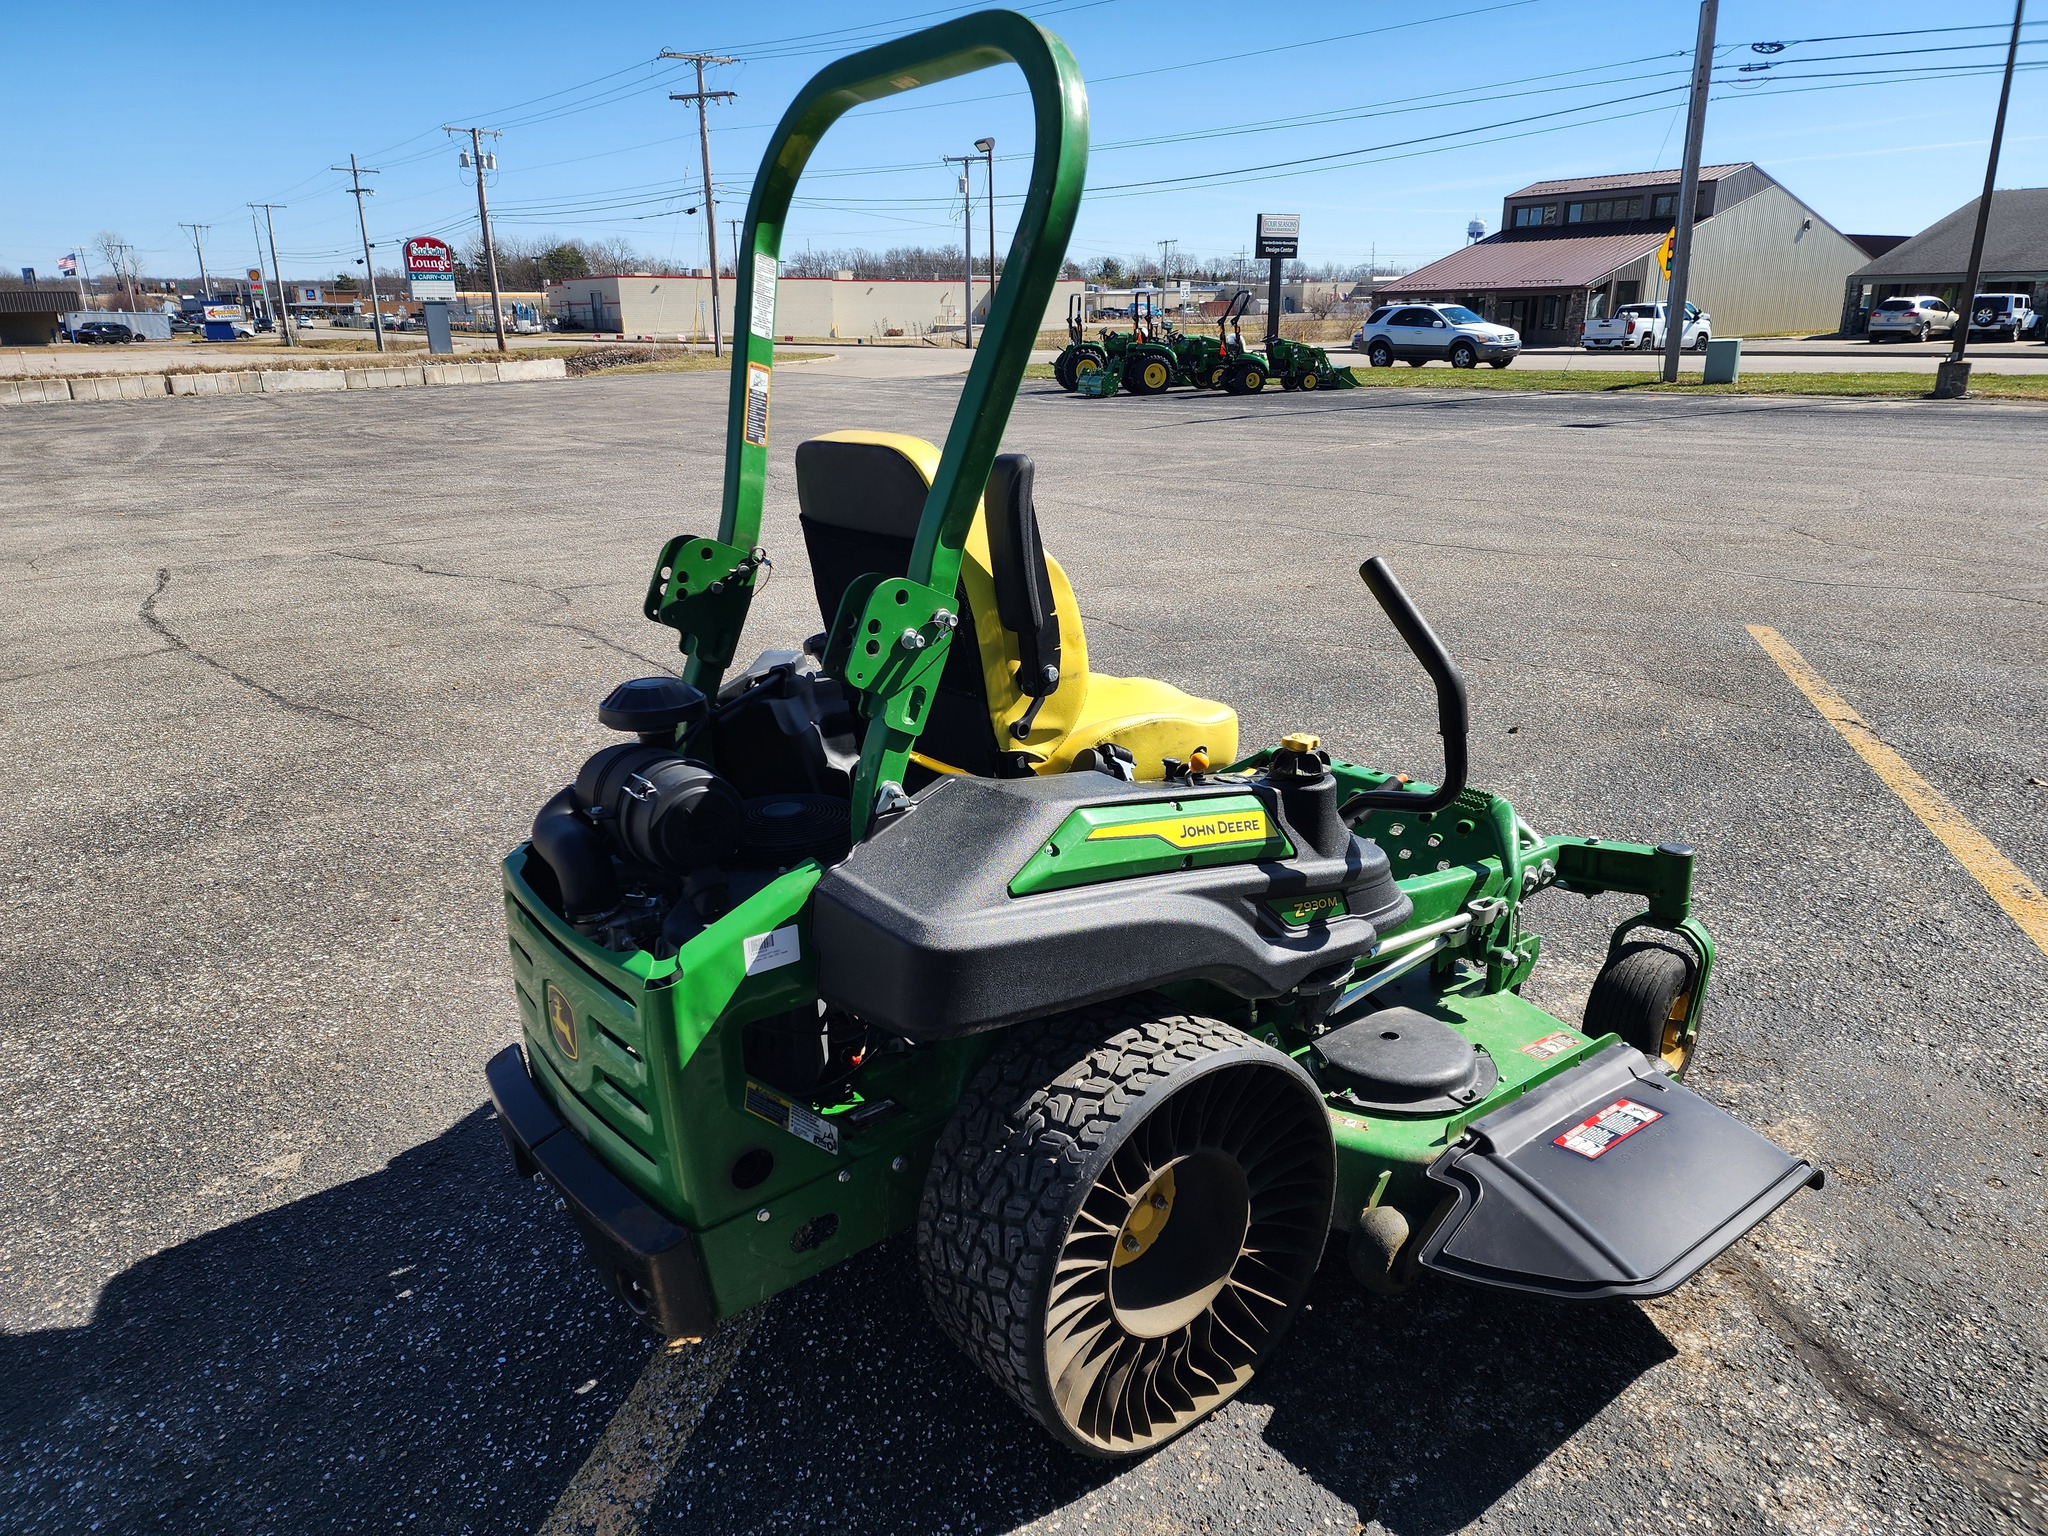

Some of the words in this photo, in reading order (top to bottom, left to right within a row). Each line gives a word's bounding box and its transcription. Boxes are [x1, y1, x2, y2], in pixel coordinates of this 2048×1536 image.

[409, 256, 451, 271] Lounge
[1181, 290, 1190, 298] 35
[1180, 824, 1216, 838] JOHN
[1217, 819, 1260, 834] DEERE
